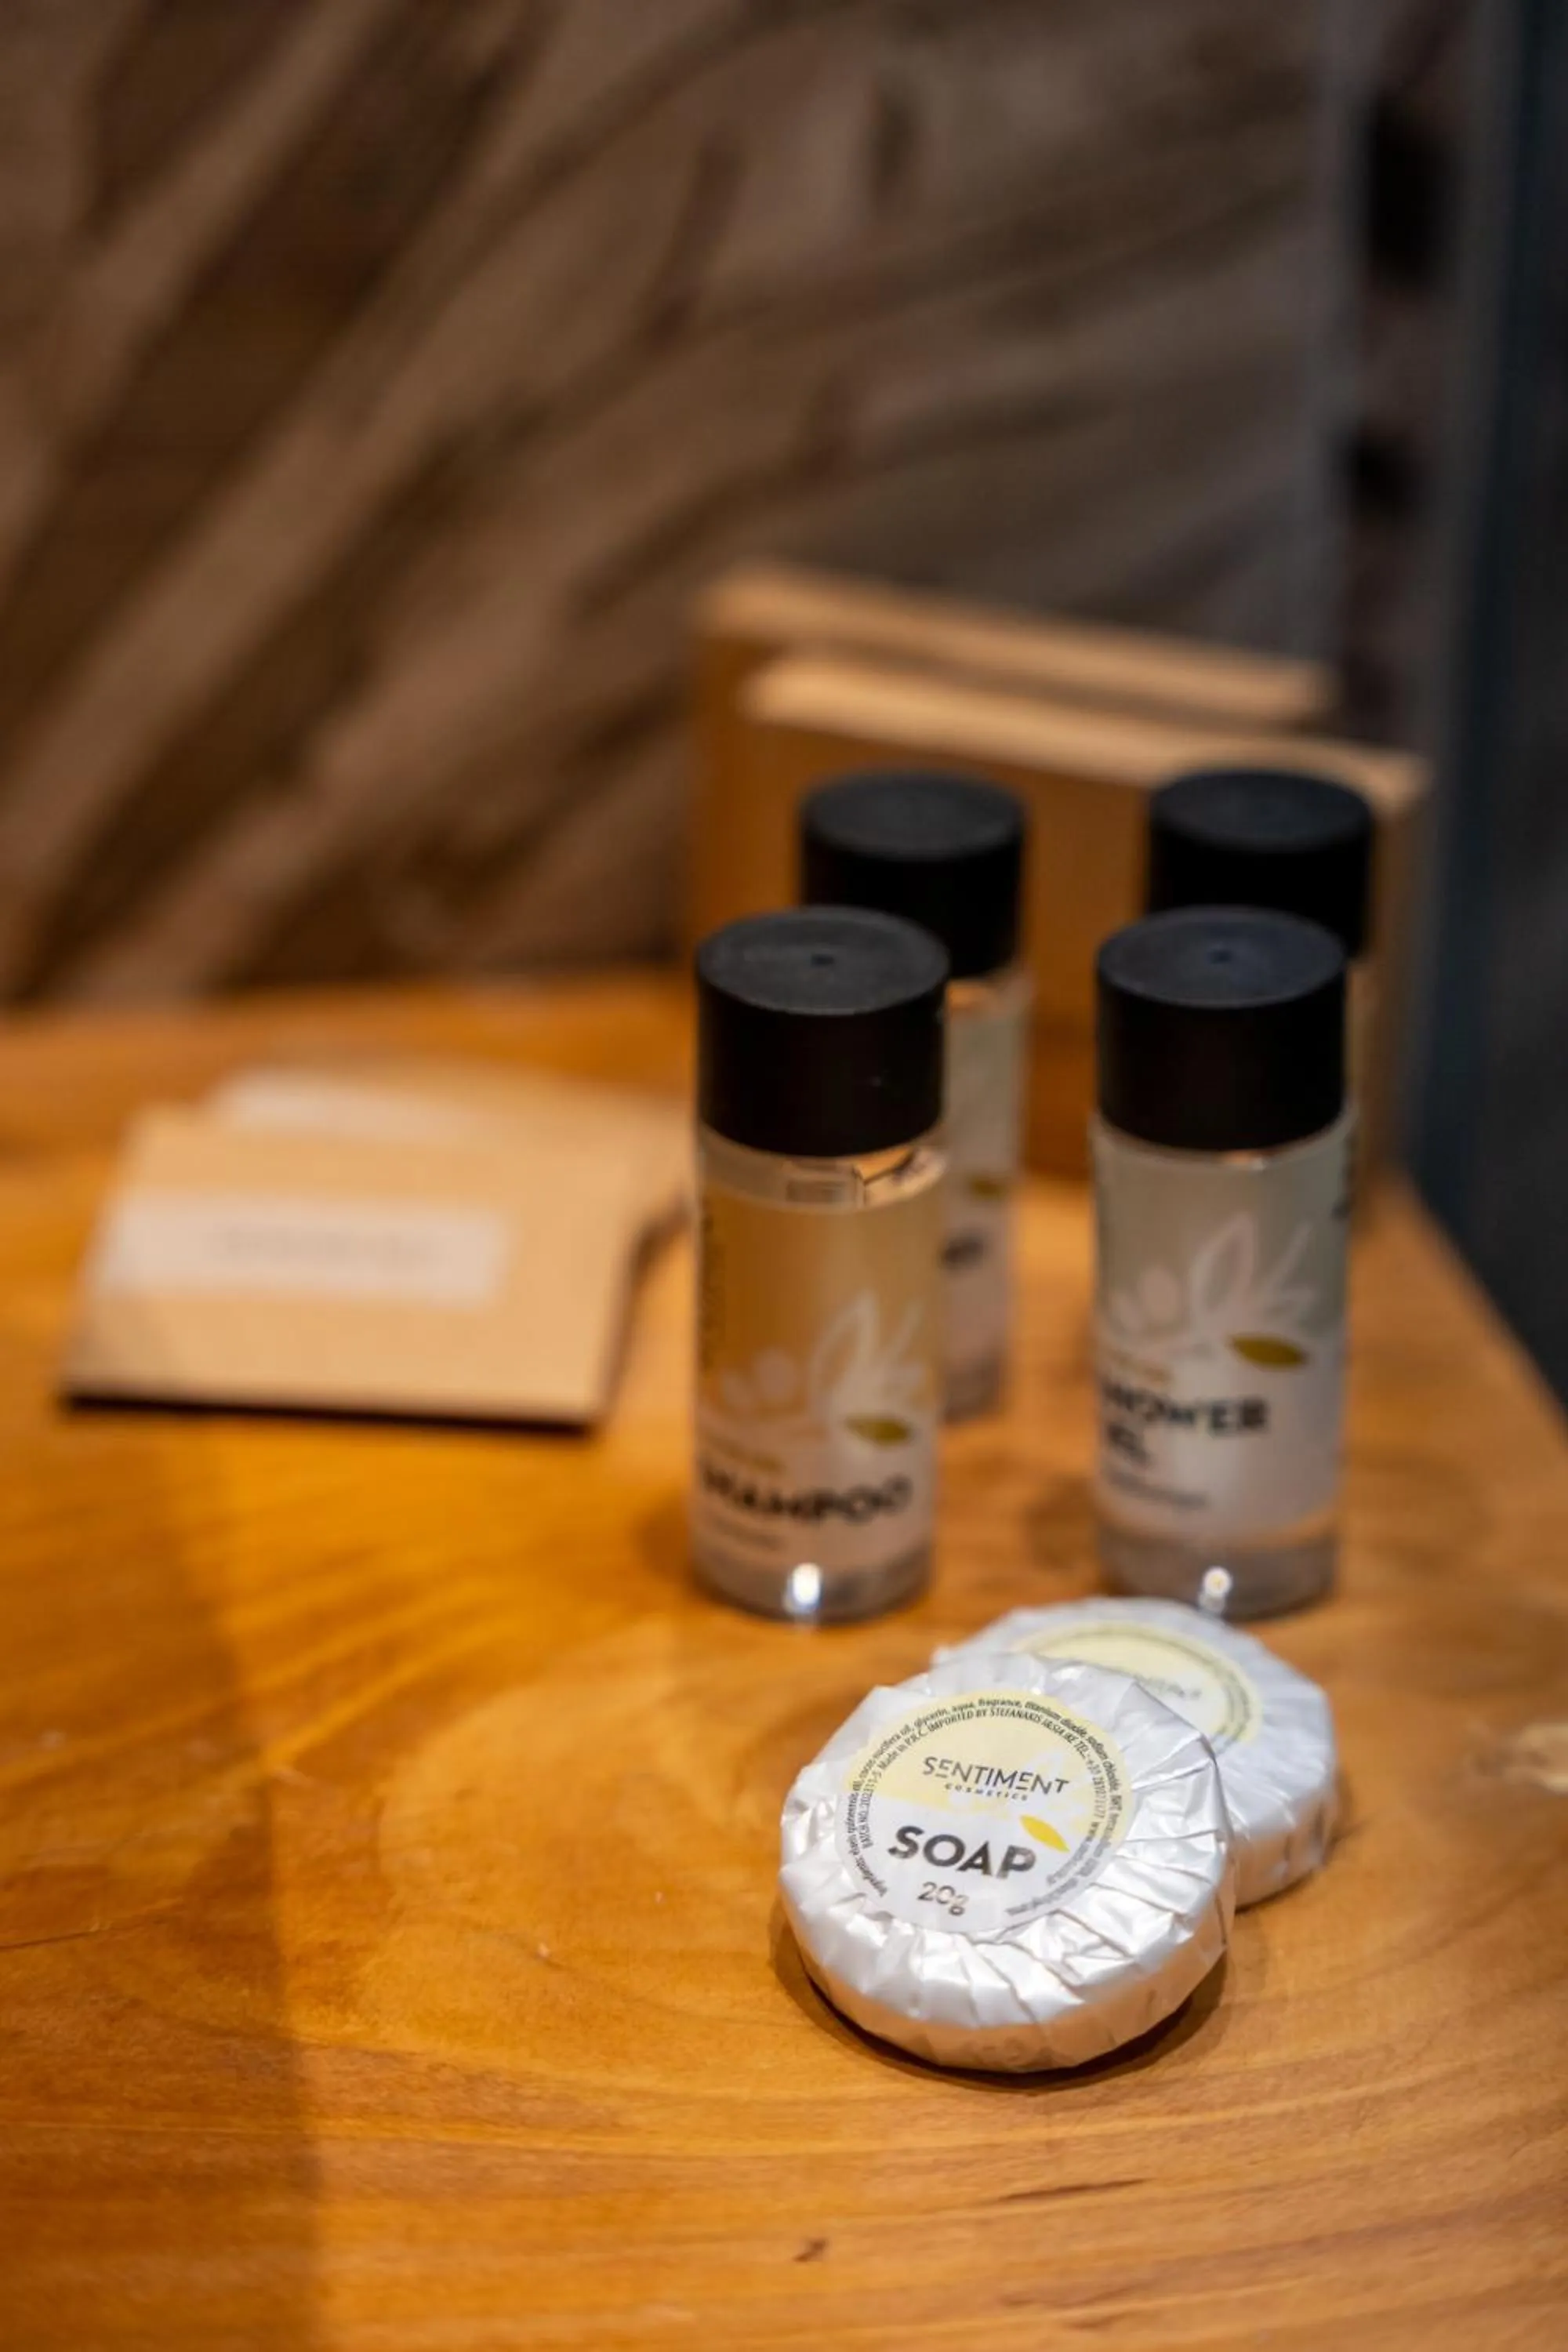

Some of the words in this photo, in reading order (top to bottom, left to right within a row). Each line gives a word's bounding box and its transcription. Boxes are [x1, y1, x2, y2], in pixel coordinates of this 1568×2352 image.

[927, 1711, 975, 1732] IMPORTED
[922, 1756, 1069, 1795] SENTIMENT
[887, 1825, 1036, 1879] SOAP
[916, 1881, 969, 1917] 20g
